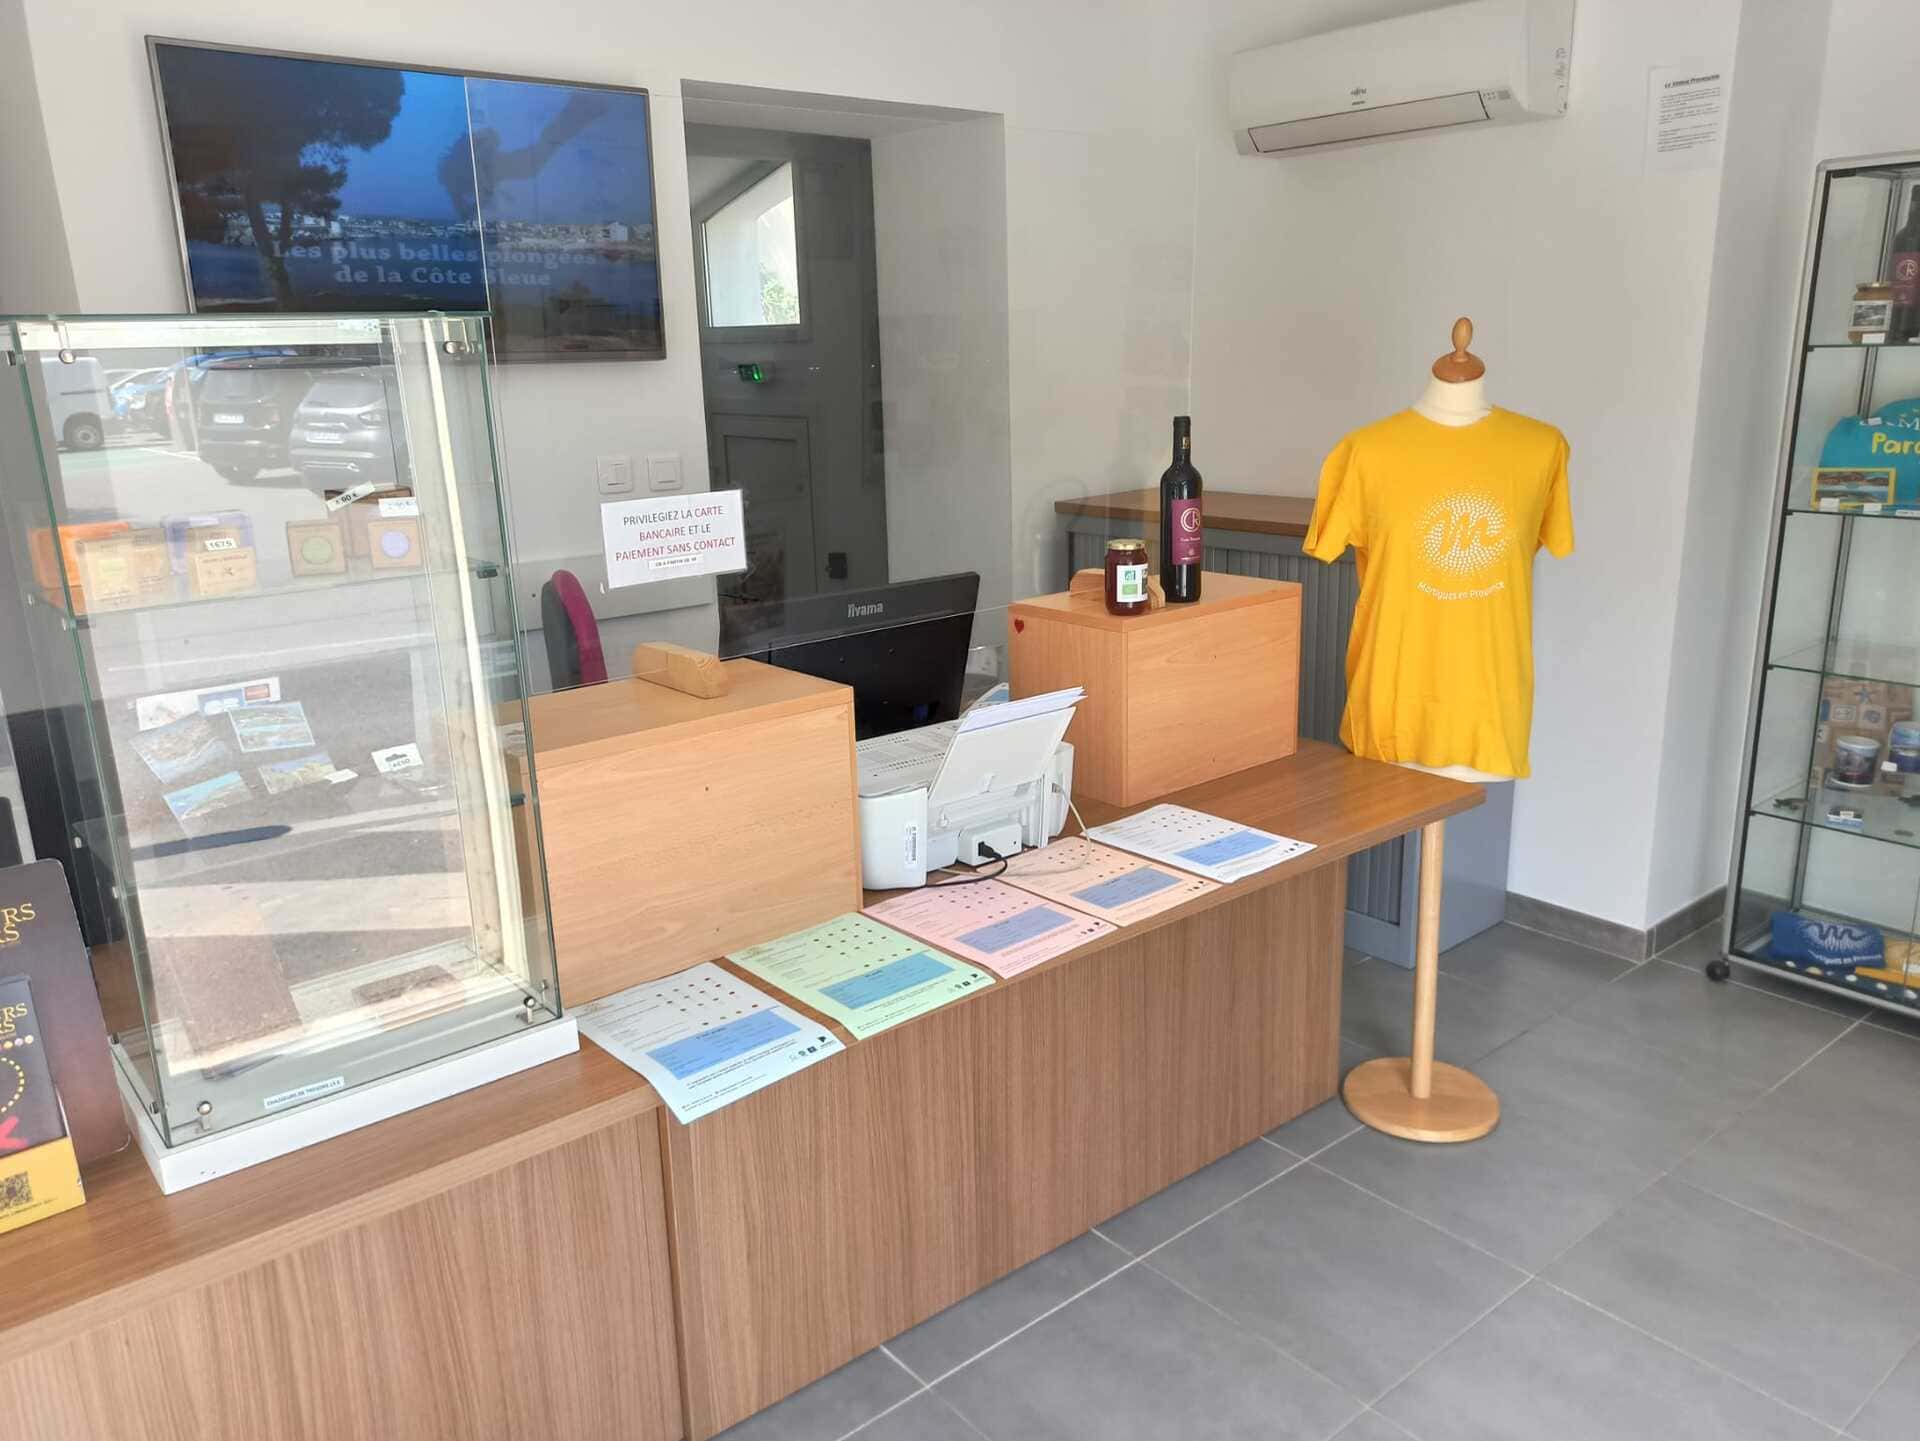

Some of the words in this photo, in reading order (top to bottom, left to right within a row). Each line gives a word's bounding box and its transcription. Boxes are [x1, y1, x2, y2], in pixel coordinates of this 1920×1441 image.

[272, 240, 322, 258] Les
[332, 241, 391, 264] plus
[398, 242, 478, 261] belles
[335, 265, 368, 283] de
[376, 265, 402, 283] la
[415, 267, 472, 284] Côte
[623, 511, 680, 526] PRIVILEGIEZ
[681, 509, 693, 519] LA
[694, 506, 723, 518] CARTE
[640, 527, 686, 541] BANCAIRE
[688, 525, 699, 535] ET
[701, 523, 711, 534] LE
[616, 546, 666, 561] PAIEMENT
[667, 543, 692, 554] SANS
[694, 537, 735, 551] CONTACT
